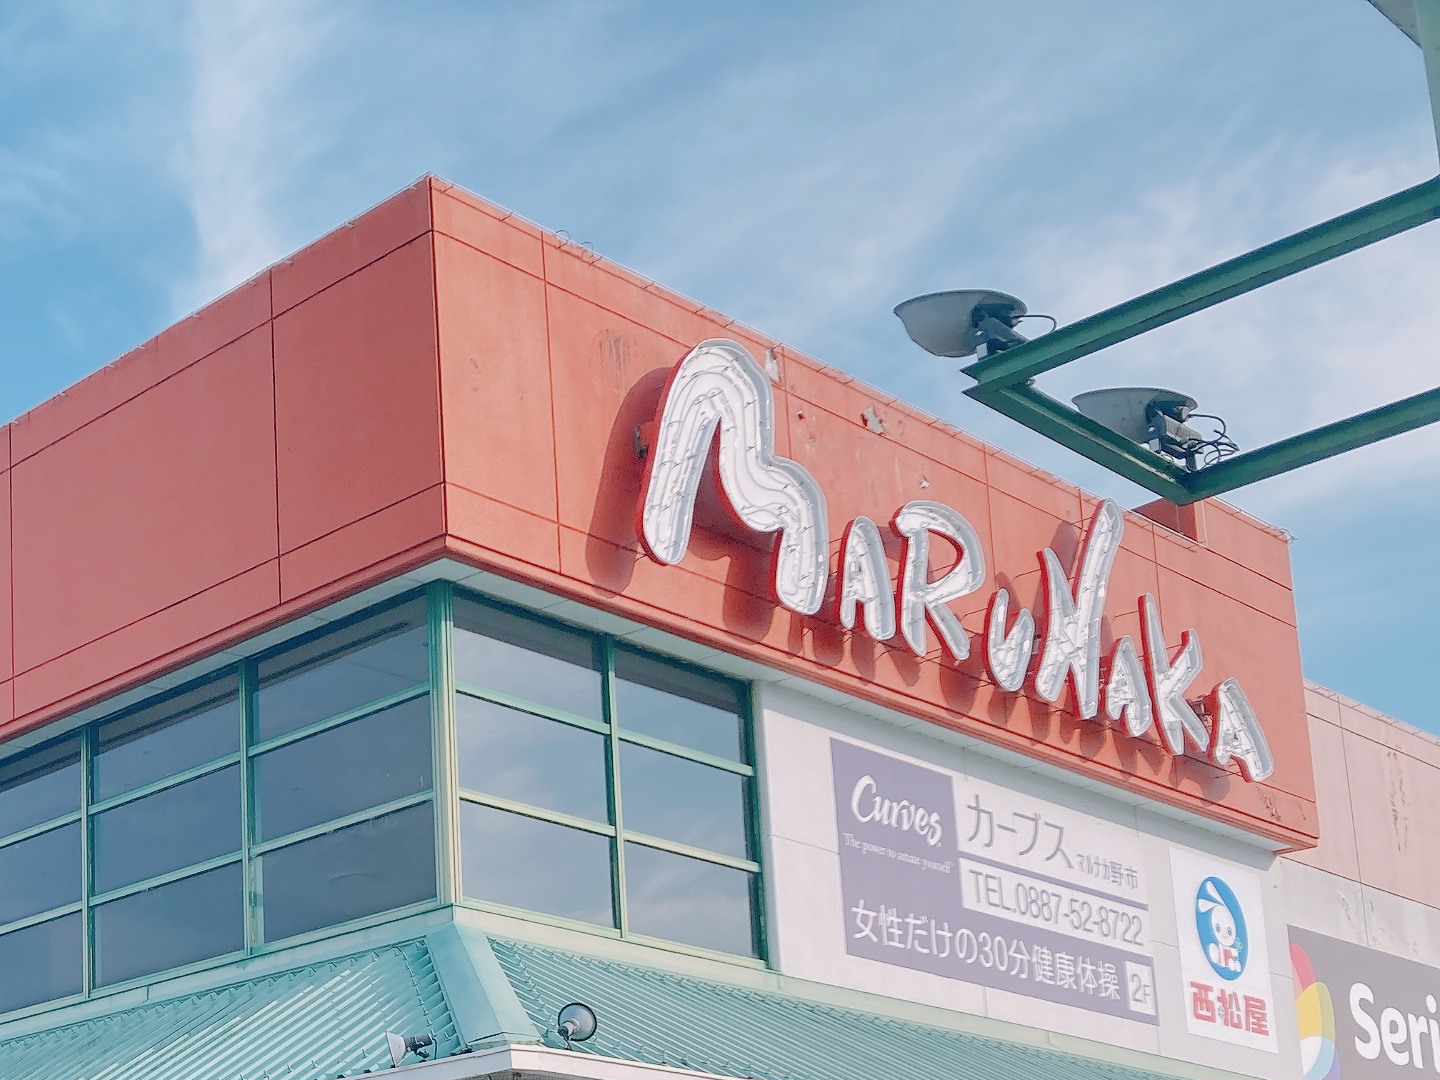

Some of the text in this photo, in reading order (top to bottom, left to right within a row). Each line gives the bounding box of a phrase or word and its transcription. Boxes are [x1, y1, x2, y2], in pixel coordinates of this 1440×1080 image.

[638, 338, 1273, 782] MARUNAKA
[843, 833, 860, 848] The
[862, 842, 886, 854] power
[887, 849, 897, 858] to
[851, 775, 942, 846] Curves
[967, 794, 1073, 869] カーブス
[969, 869, 1143, 946] TEL.0887-52-8722
[851, 899, 1120, 1000] 女性だけの30分健康体操
[1131, 973, 1151, 1005] 2F
[1190, 981, 1269, 1036] 西松屋
[1349, 982, 1440, 1074] Seri
